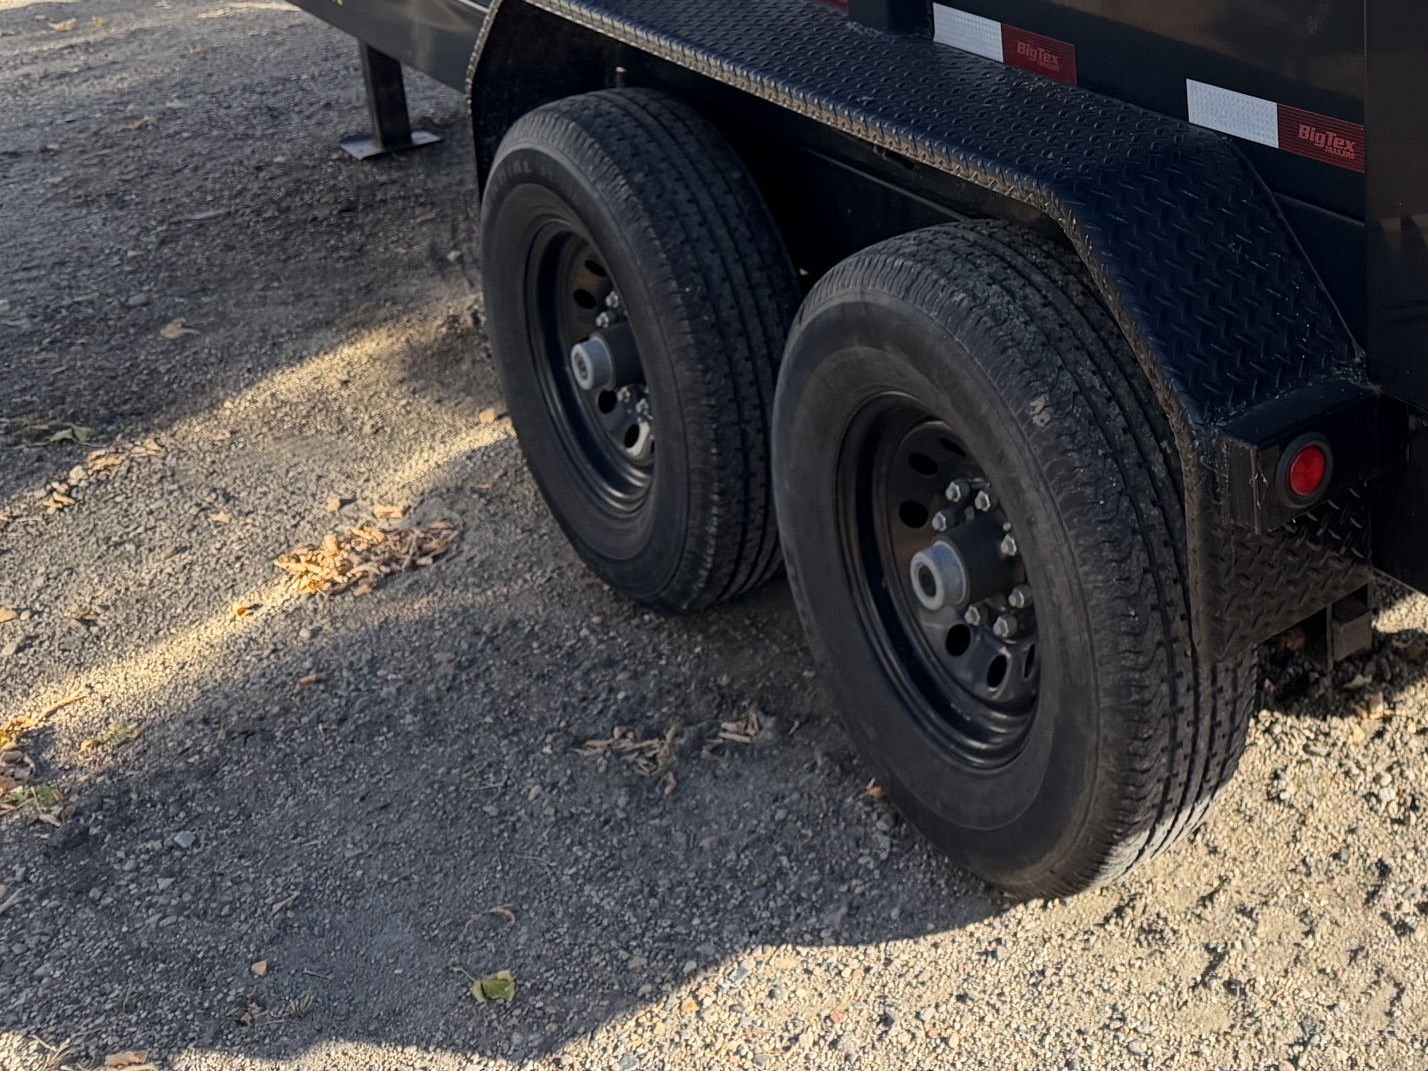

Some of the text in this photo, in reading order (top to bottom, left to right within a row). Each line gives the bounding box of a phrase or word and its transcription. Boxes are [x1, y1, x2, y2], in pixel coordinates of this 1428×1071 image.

[1016, 40, 1060, 66] BigTex
[1298, 123, 1355, 153] BigTex
[1324, 145, 1357, 160] TRAILERS
